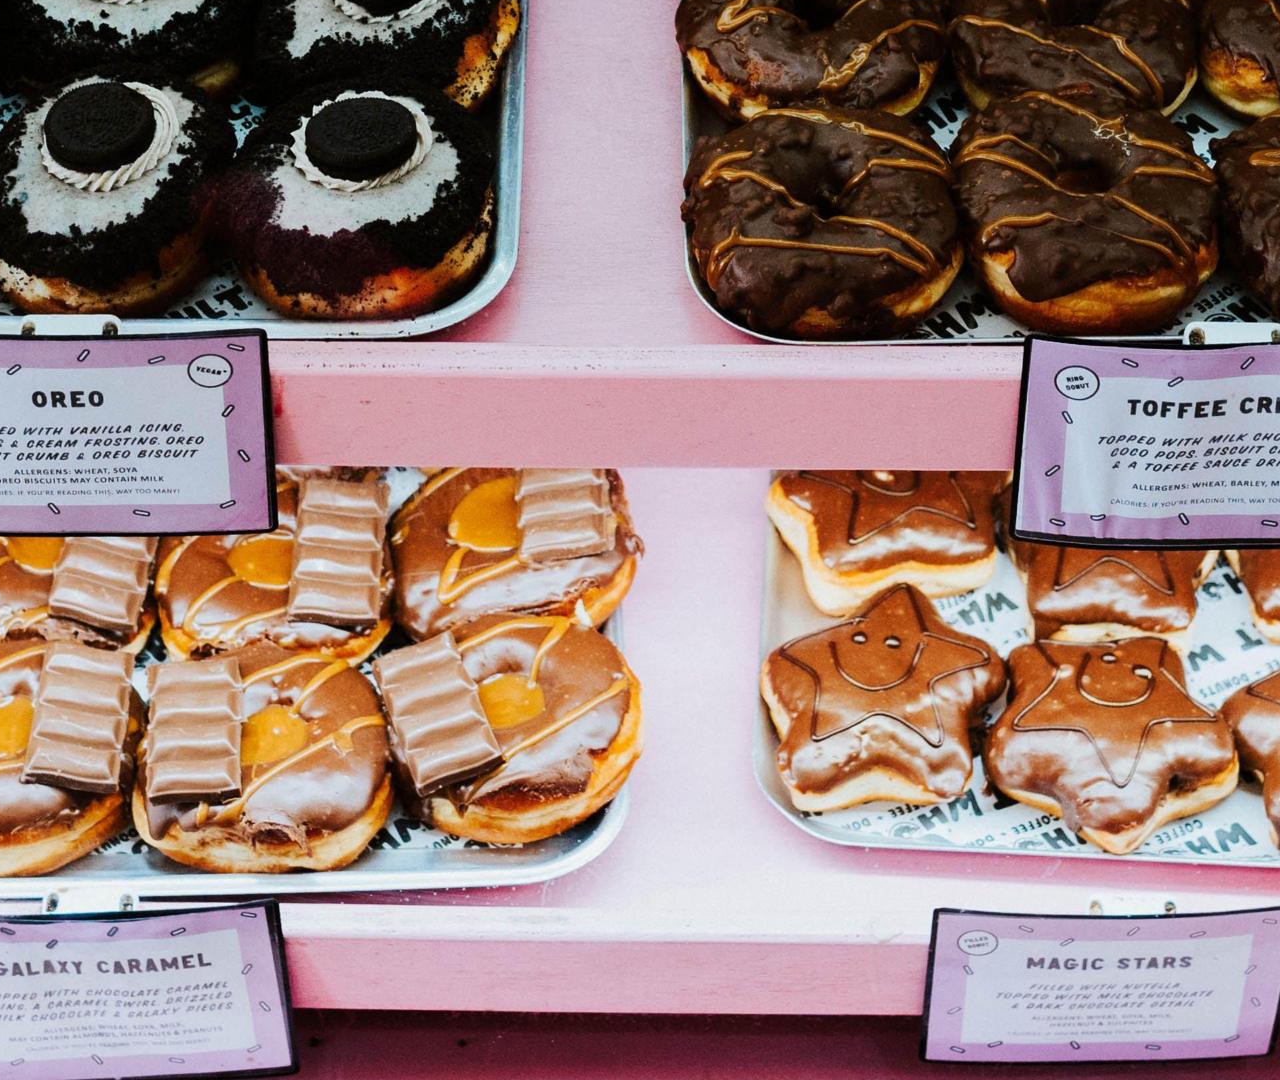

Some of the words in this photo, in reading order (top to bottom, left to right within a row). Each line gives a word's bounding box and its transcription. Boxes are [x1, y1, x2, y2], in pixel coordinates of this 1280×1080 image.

[31, 390, 104, 408] OREO
[1128, 399, 1227, 419] TOFFEE
[23, 426, 64, 436] WITH
[69, 425, 132, 435] VANILLA
[10, 439, 19, 448] &
[26, 439, 79, 449] CREAM
[165, 435, 205, 446] OREO
[1097, 435, 1156, 446] TOPPED
[1161, 437, 1204, 447] WITH
[1208, 433, 1248, 444] MILK
[16, 452, 70, 461] CRUMB
[76, 452, 85, 461] &
[92, 449, 131, 460] OREO
[137, 449, 199, 459] BISCUIT
[1110, 447, 1149, 457] COCO
[1203, 445, 1265, 457] BISCUIT
[1112, 461, 1121, 469] &
[1128, 461, 1137, 469] A
[1144, 461, 1200, 472] TOFFEE
[1203, 458, 1252, 469] SAUCE
[96, 953, 212, 974] CARAMEL
[1026, 957, 1104, 971] MAGIC
[1117, 956, 1193, 970] STARS
